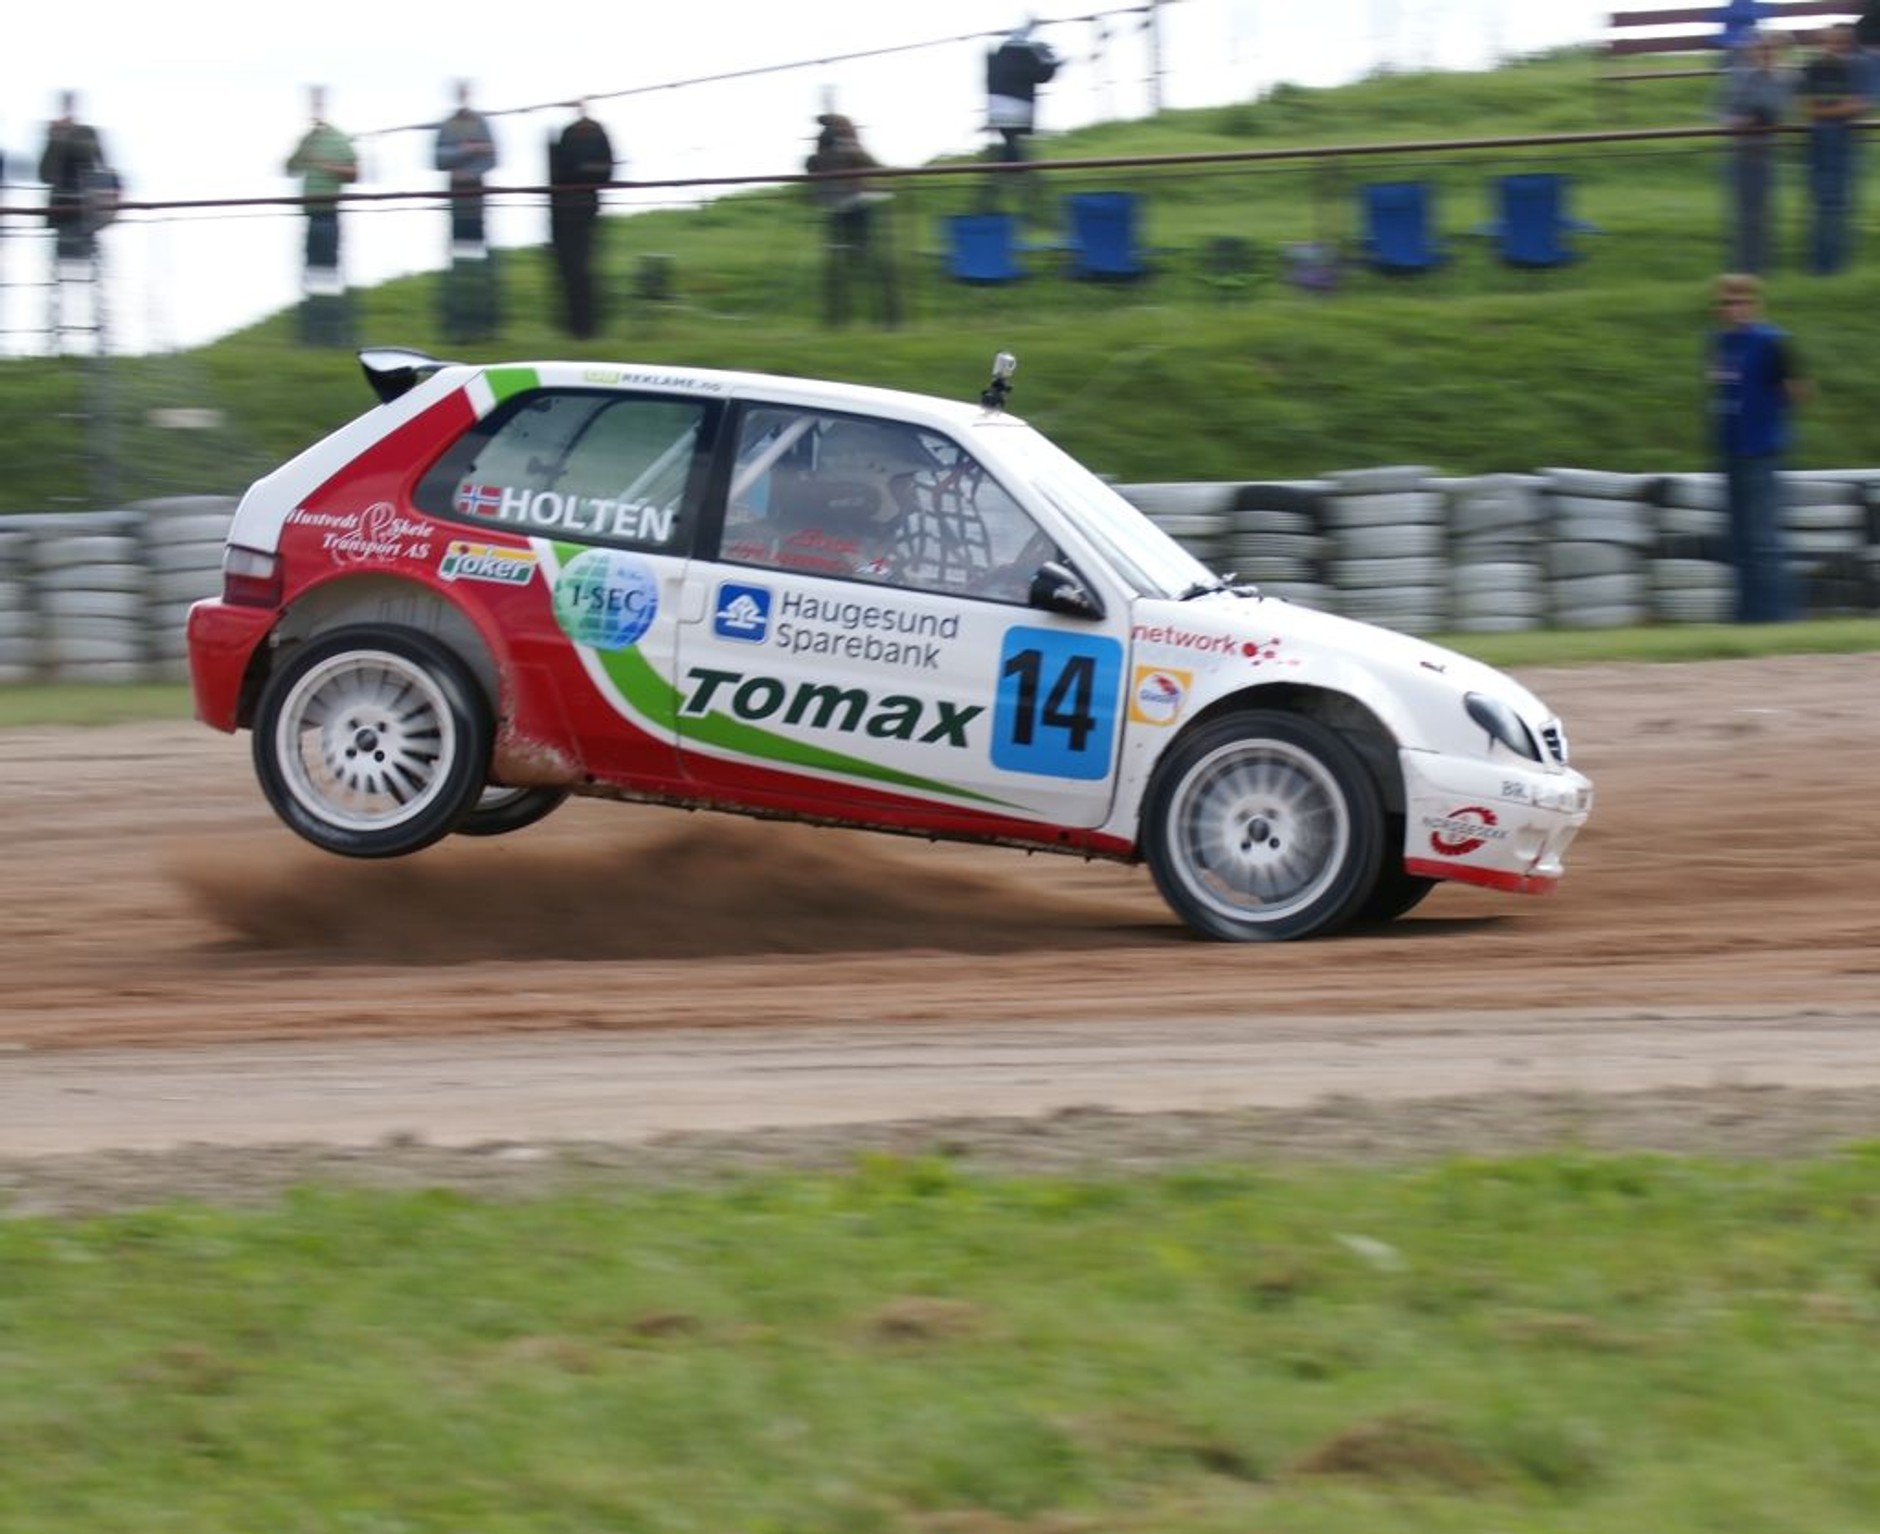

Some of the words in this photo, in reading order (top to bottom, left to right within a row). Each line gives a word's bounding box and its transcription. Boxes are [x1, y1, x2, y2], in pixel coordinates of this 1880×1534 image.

[500, 487, 673, 541] HOLTEN
[322, 533, 402, 557] Transport
[571, 584, 645, 613] I-SEC
[782, 591, 960, 640] Haugesund
[776, 623, 940, 669] Sparebank
[1131, 624, 1238, 655] network
[1003, 648, 1097, 752] 14
